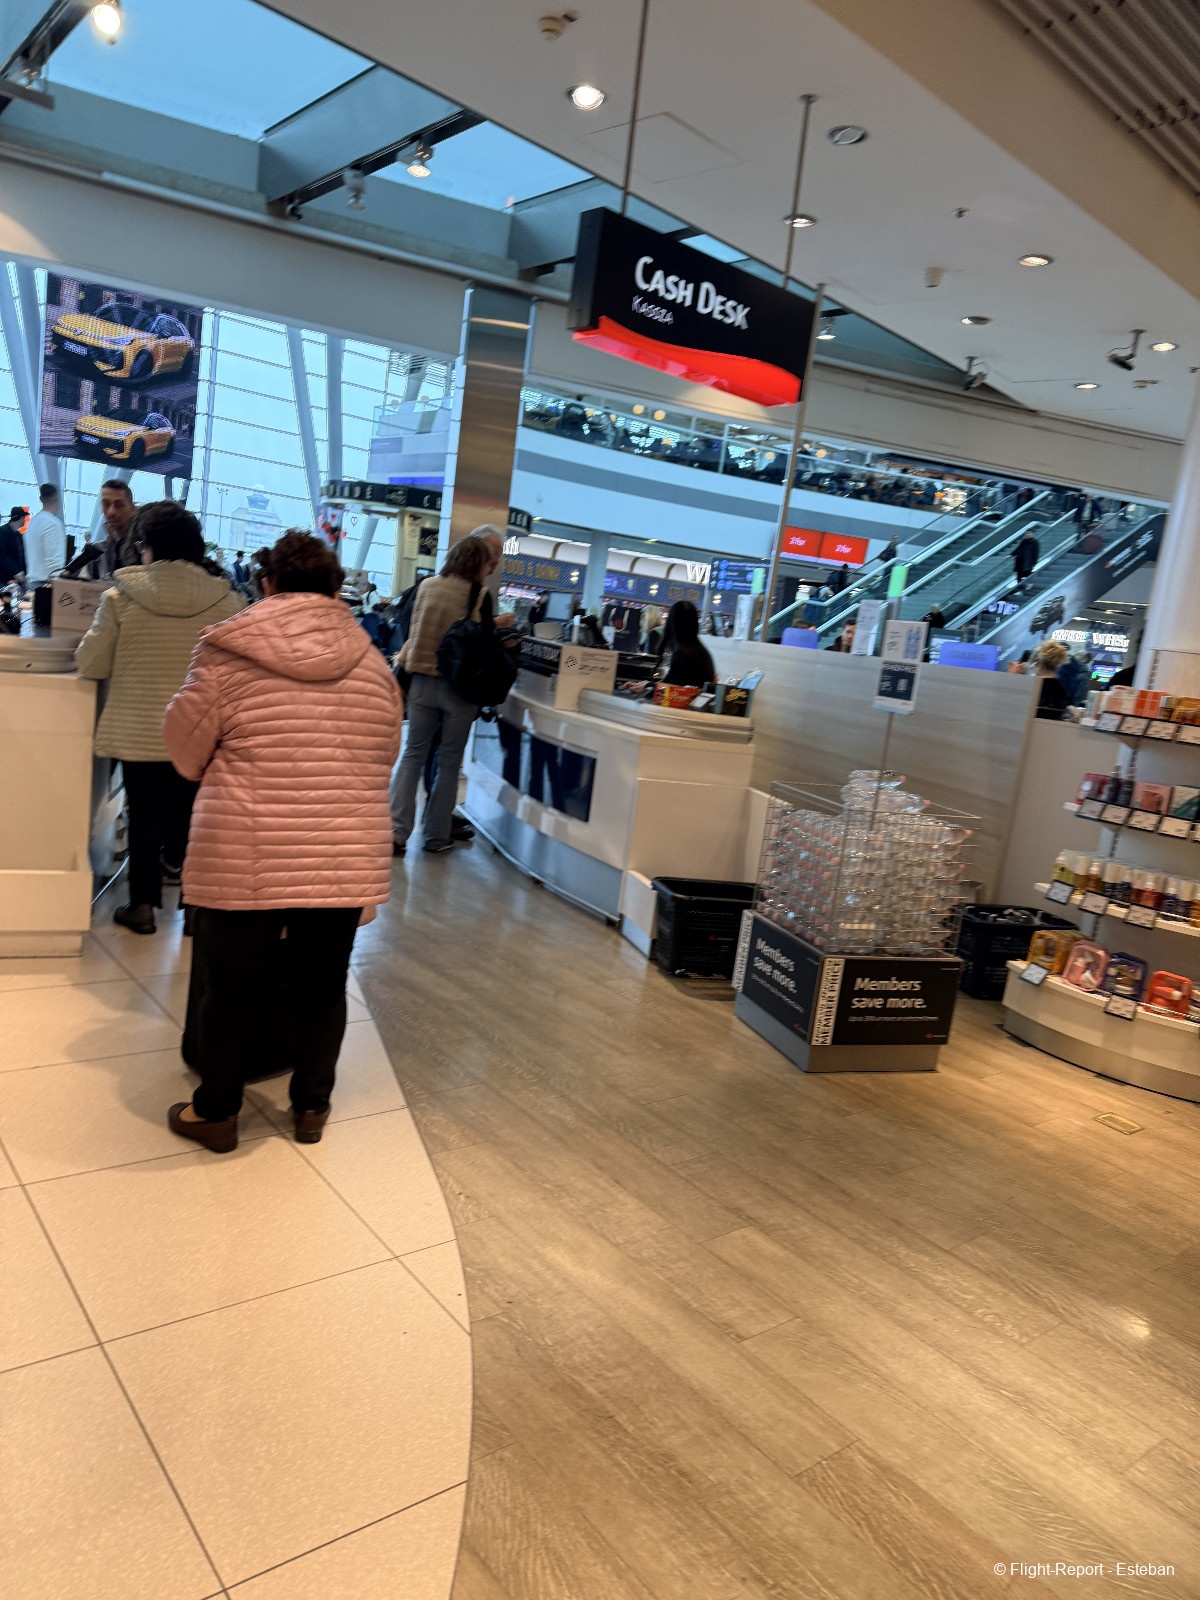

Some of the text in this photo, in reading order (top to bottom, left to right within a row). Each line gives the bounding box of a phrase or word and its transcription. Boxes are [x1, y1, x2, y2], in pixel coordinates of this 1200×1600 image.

[635, 255, 751, 330] CASH DESK
[756, 938, 795, 972] Members
[753, 957, 773, 976] save
[772, 969, 798, 994] more.
[854, 977, 922, 991] Members
[820, 995, 836, 1044] MEMBER
[828, 960, 842, 992] PRICE
[851, 997, 928, 1009] save more.
